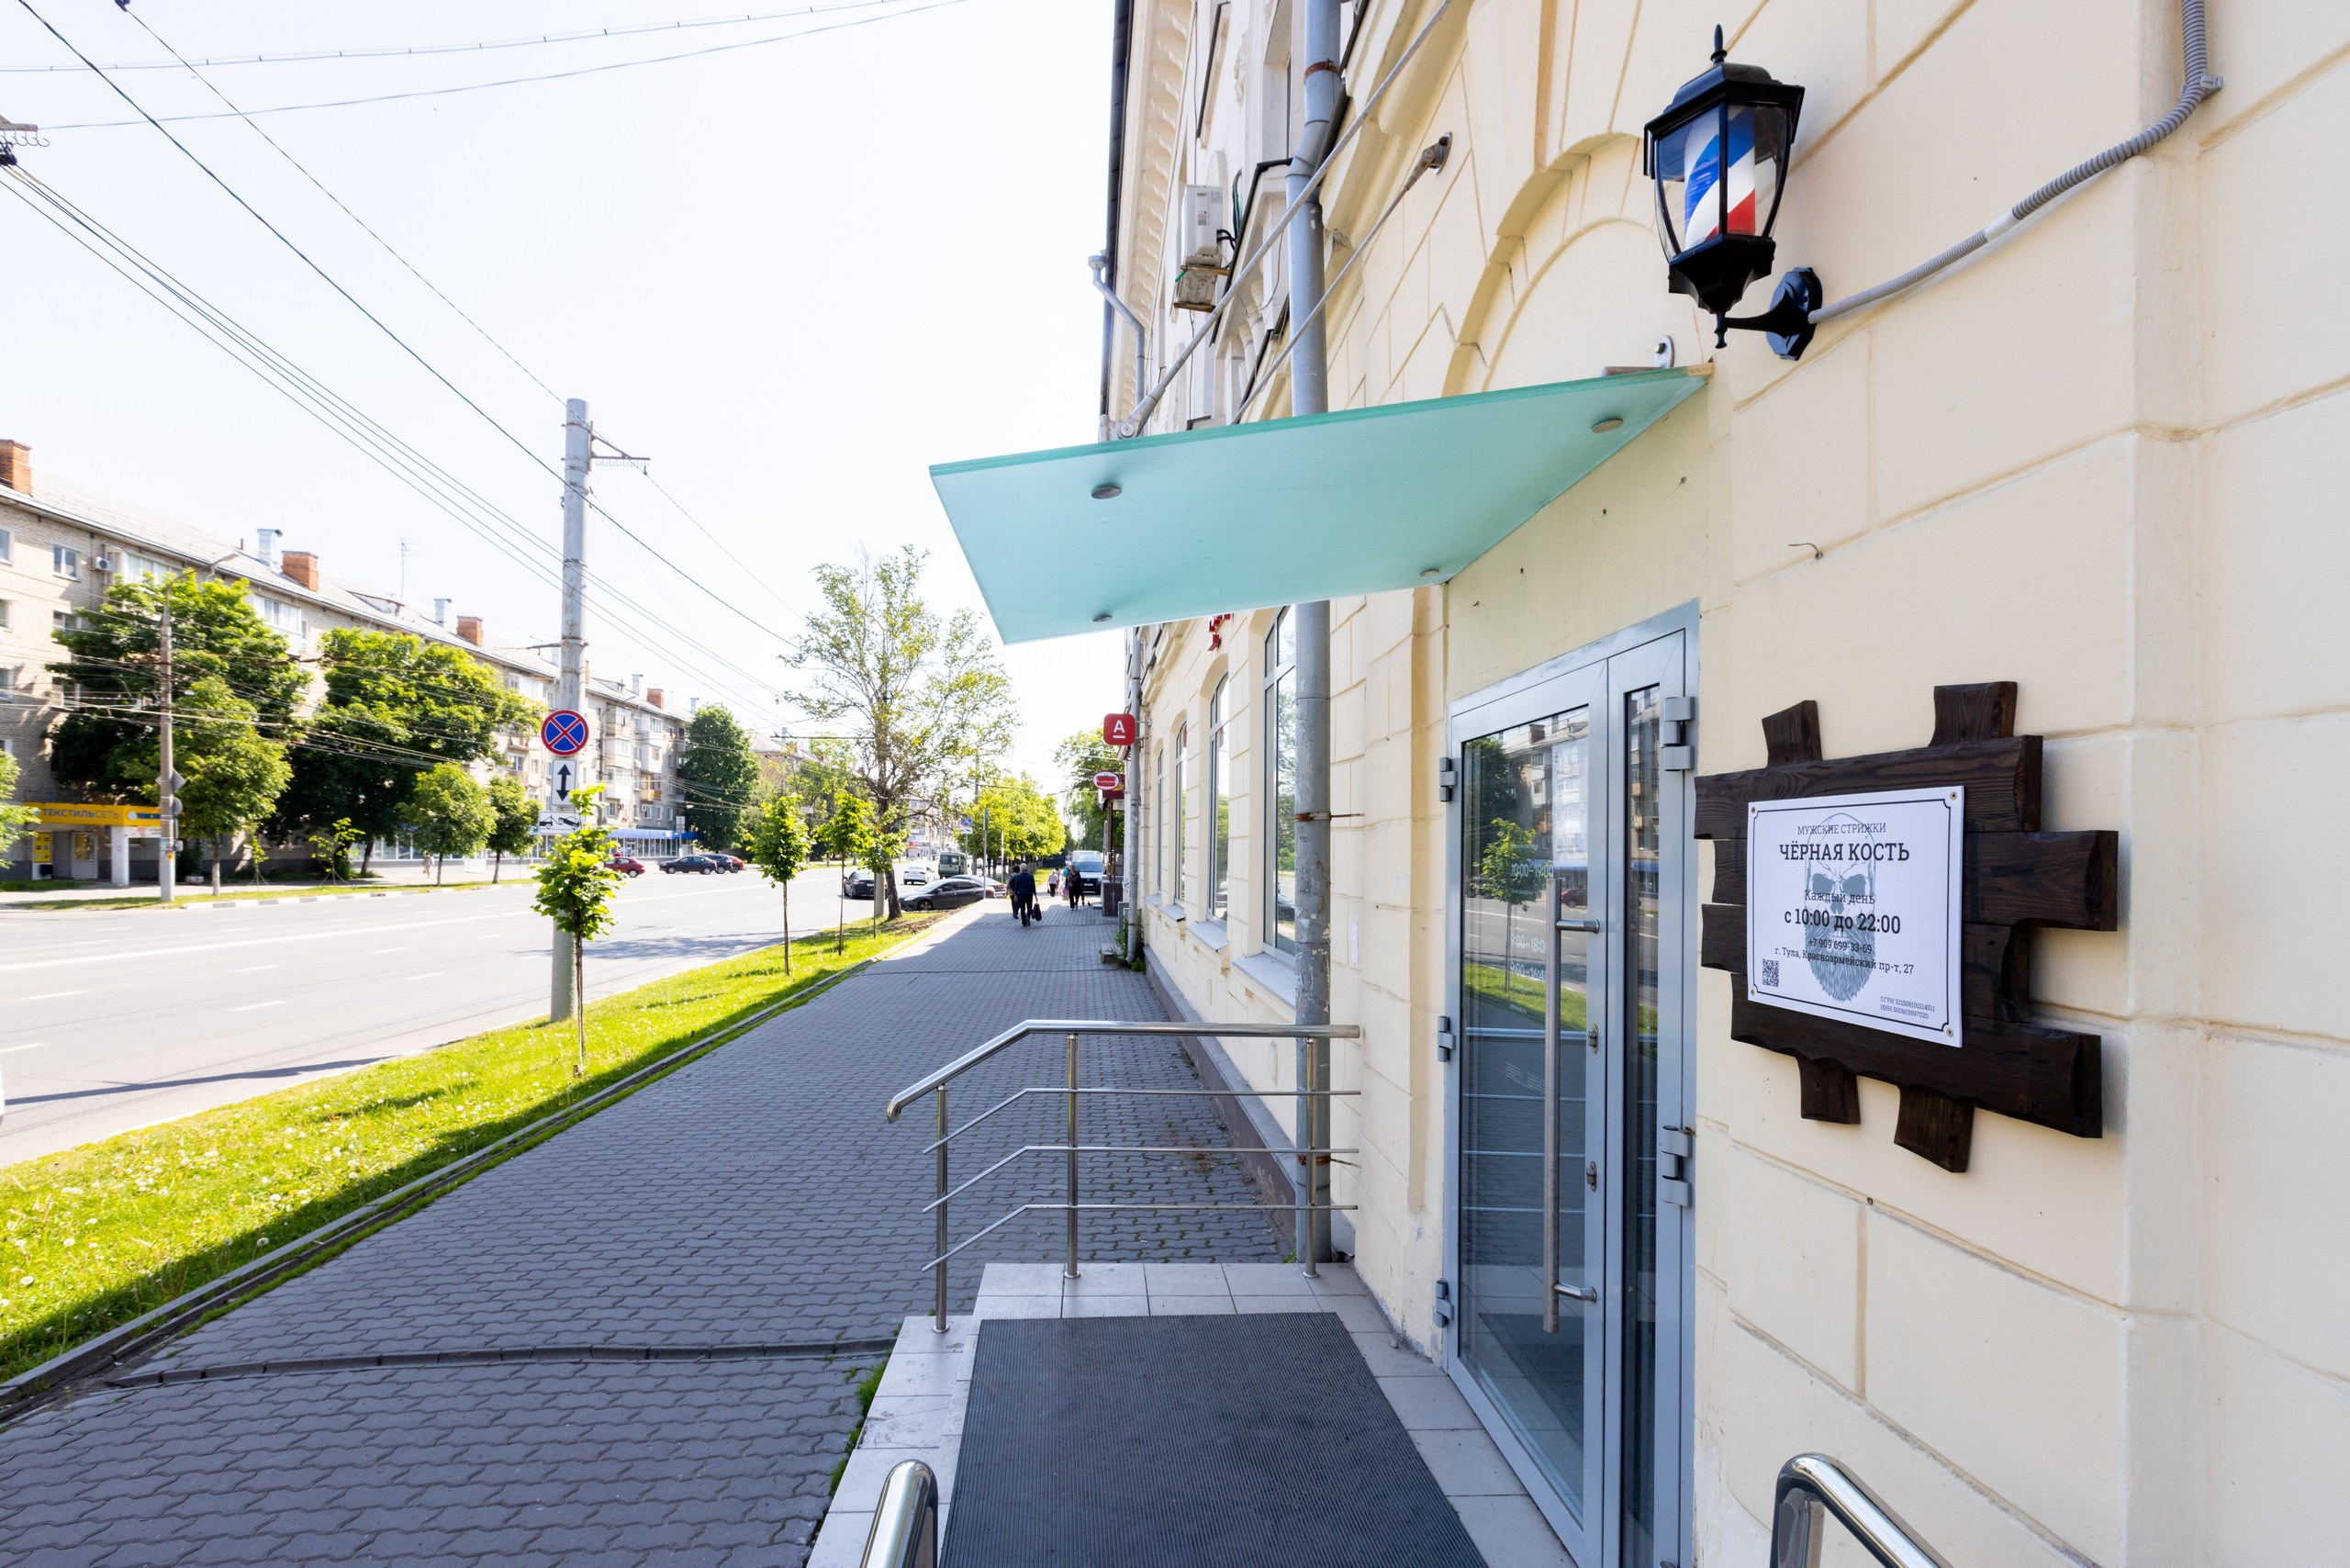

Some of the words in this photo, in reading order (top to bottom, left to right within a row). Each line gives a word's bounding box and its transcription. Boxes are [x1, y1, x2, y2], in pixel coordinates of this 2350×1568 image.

[43, 808, 119, 819] ТЕКСТИЛЬСЕТЬ
[1797, 824, 1839, 835] МУЖСКИЕ
[1841, 823, 1886, 834] СТРИЖКИ
[1780, 841, 1843, 861] ЧЁРНАЯ
[1848, 843, 1909, 861] КОСТЬ
[1805, 890, 1846, 903] Каждый
[1849, 894, 1875, 905] день
[1785, 911, 1791, 924] с
[1796, 908, 1830, 927] 10:00
[1834, 916, 1853, 932] до
[1858, 913, 1901, 935] 22:00
[1782, 946, 1801, 959] Тула,
[1802, 949, 1876, 969] Красноармейский
[1878, 961, 1902, 974] пр-т,
[1903, 963, 1914, 974] 27
[1880, 996, 1894, 1004] ОГРН
